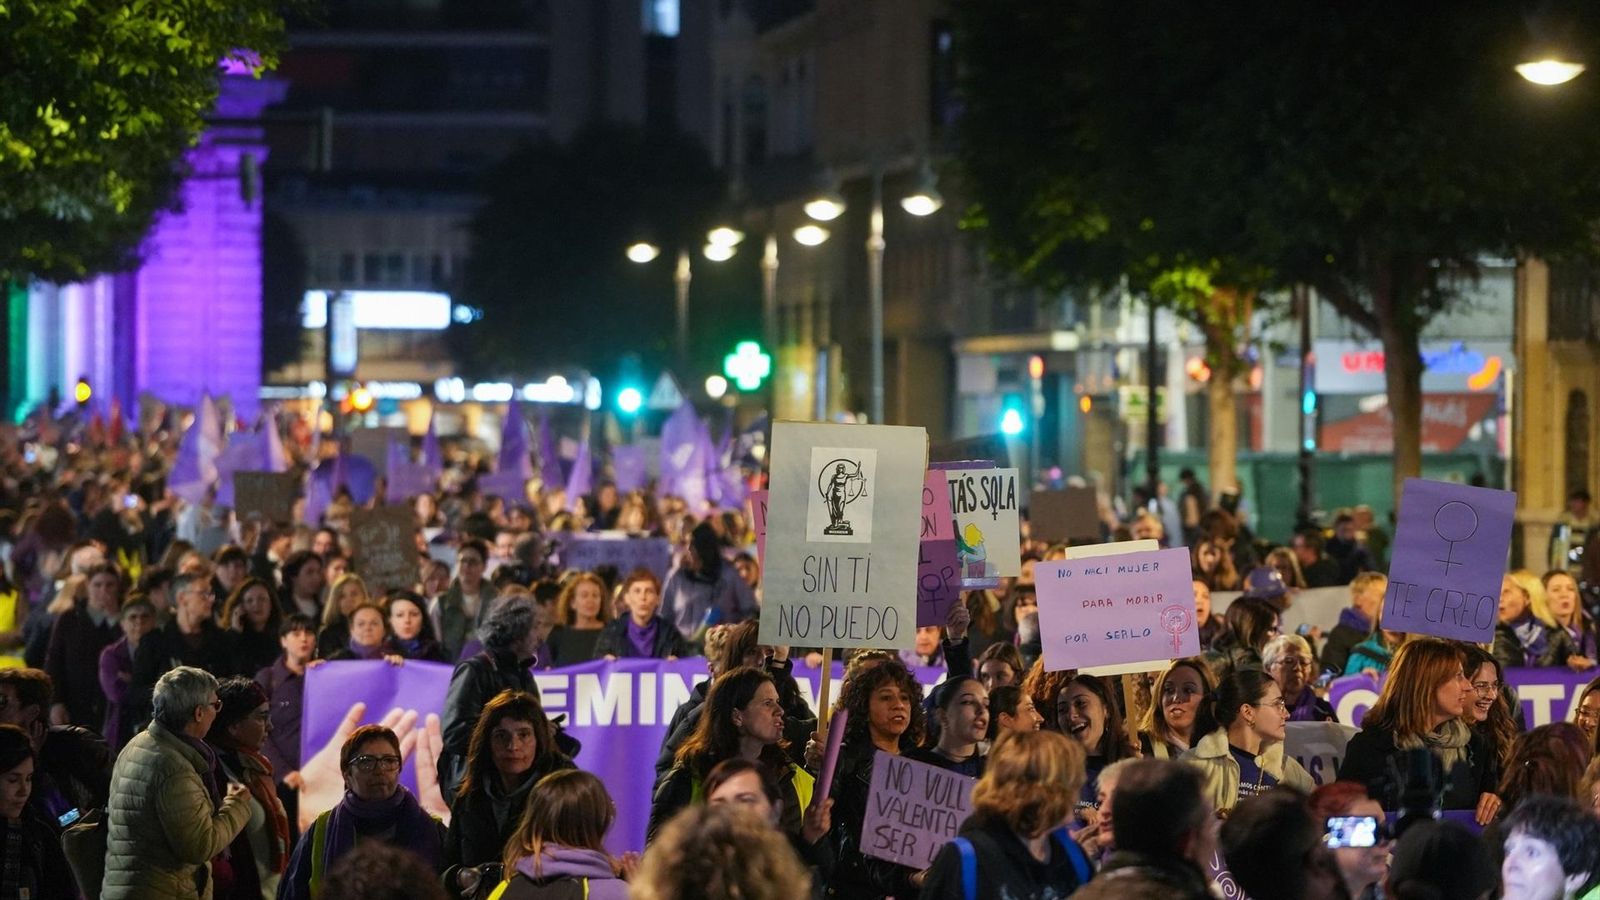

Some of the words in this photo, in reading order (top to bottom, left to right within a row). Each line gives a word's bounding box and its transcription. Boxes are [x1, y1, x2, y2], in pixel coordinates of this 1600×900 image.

[948, 473, 977, 515] TÁS
[980, 475, 1017, 520] SOLA
[802, 554, 838, 593] SIN
[1057, 568, 1072, 579] NO
[1118, 562, 1160, 574] MUJER
[1082, 598, 1113, 609] PARA
[1126, 593, 1163, 605] MORIR
[1390, 581, 1418, 618] TE
[1425, 588, 1495, 631] CREO
[778, 604, 811, 639] NO
[820, 605, 899, 641] PUEDO
[1065, 632, 1089, 644] POR
[1104, 628, 1151, 640] SERLO
[885, 758, 913, 795] NO
[925, 770, 966, 812] VULL
[876, 792, 958, 838] VALENTA
[873, 824, 917, 857] SER
